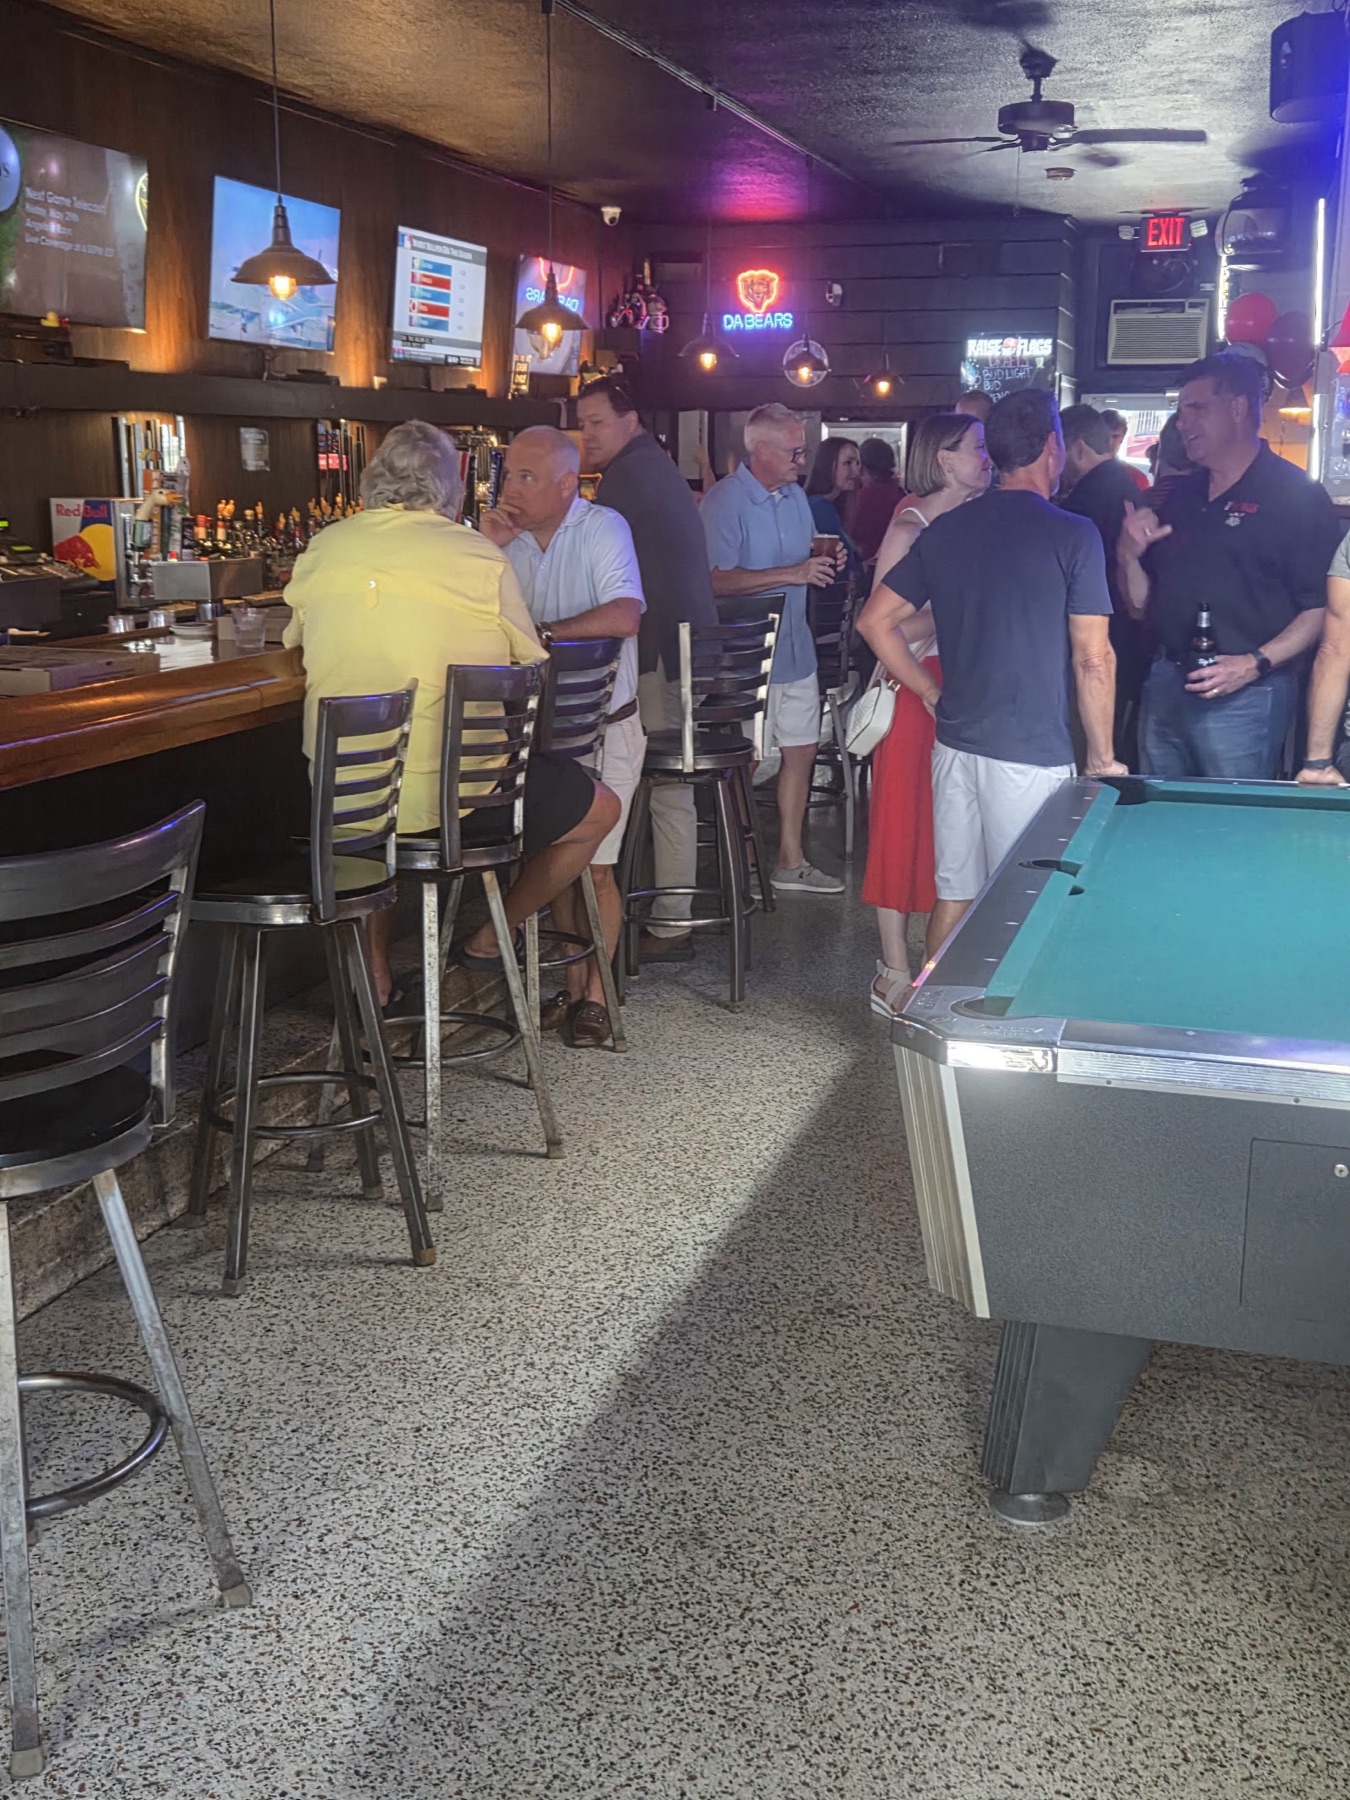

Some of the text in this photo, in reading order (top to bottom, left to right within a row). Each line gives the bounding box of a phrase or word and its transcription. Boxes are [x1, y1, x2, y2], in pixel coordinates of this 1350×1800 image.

[1147, 217, 1185, 246] EXIT
[1016, 338, 1052, 356] FLAGS
[982, 367, 1030, 381] BUD LIGHT
[983, 380, 1002, 391] BUD
[55, 504, 108, 518] Red Bull
